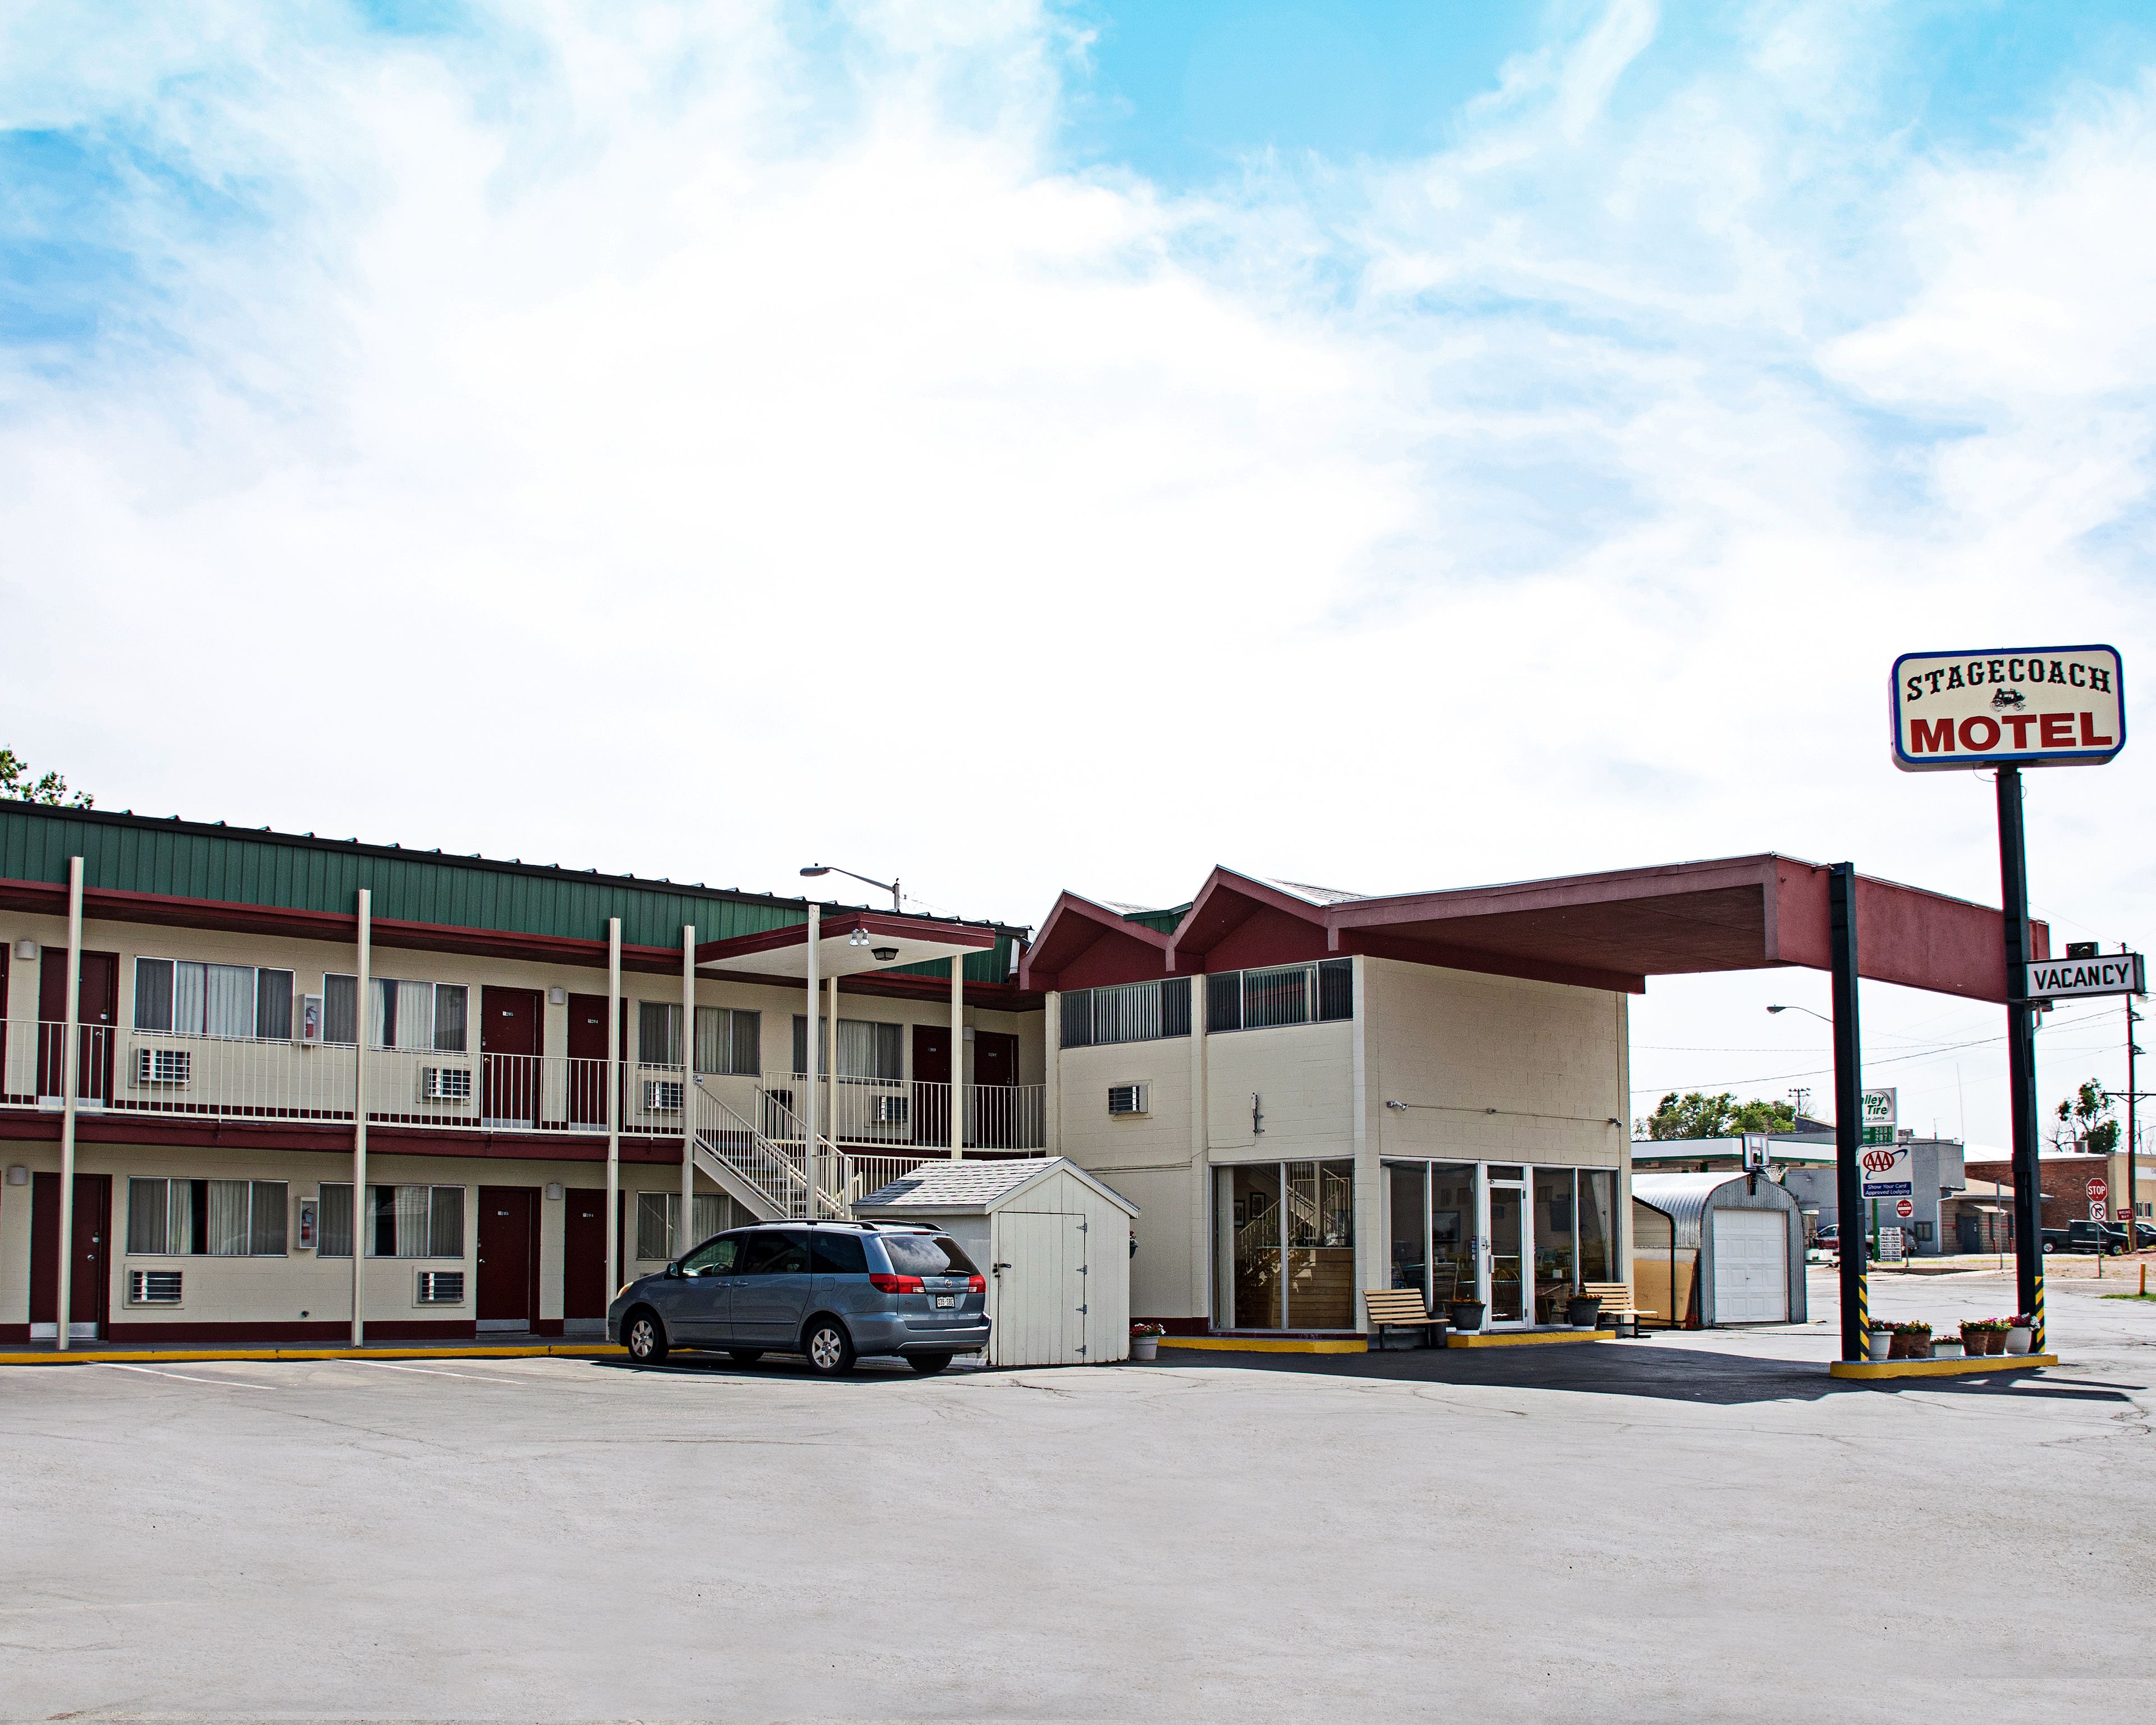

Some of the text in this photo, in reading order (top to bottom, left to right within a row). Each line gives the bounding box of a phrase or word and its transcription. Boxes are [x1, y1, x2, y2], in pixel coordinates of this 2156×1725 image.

[1907, 658, 2112, 702] STAGECOACH
[1910, 711, 2113, 754] MOTEL
[2033, 962, 2129, 990] VACANCY
[1867, 1105, 1888, 1115] Tire
[1866, 1151, 1892, 1172] AAA
[2088, 1185, 2106, 1195] STOP
